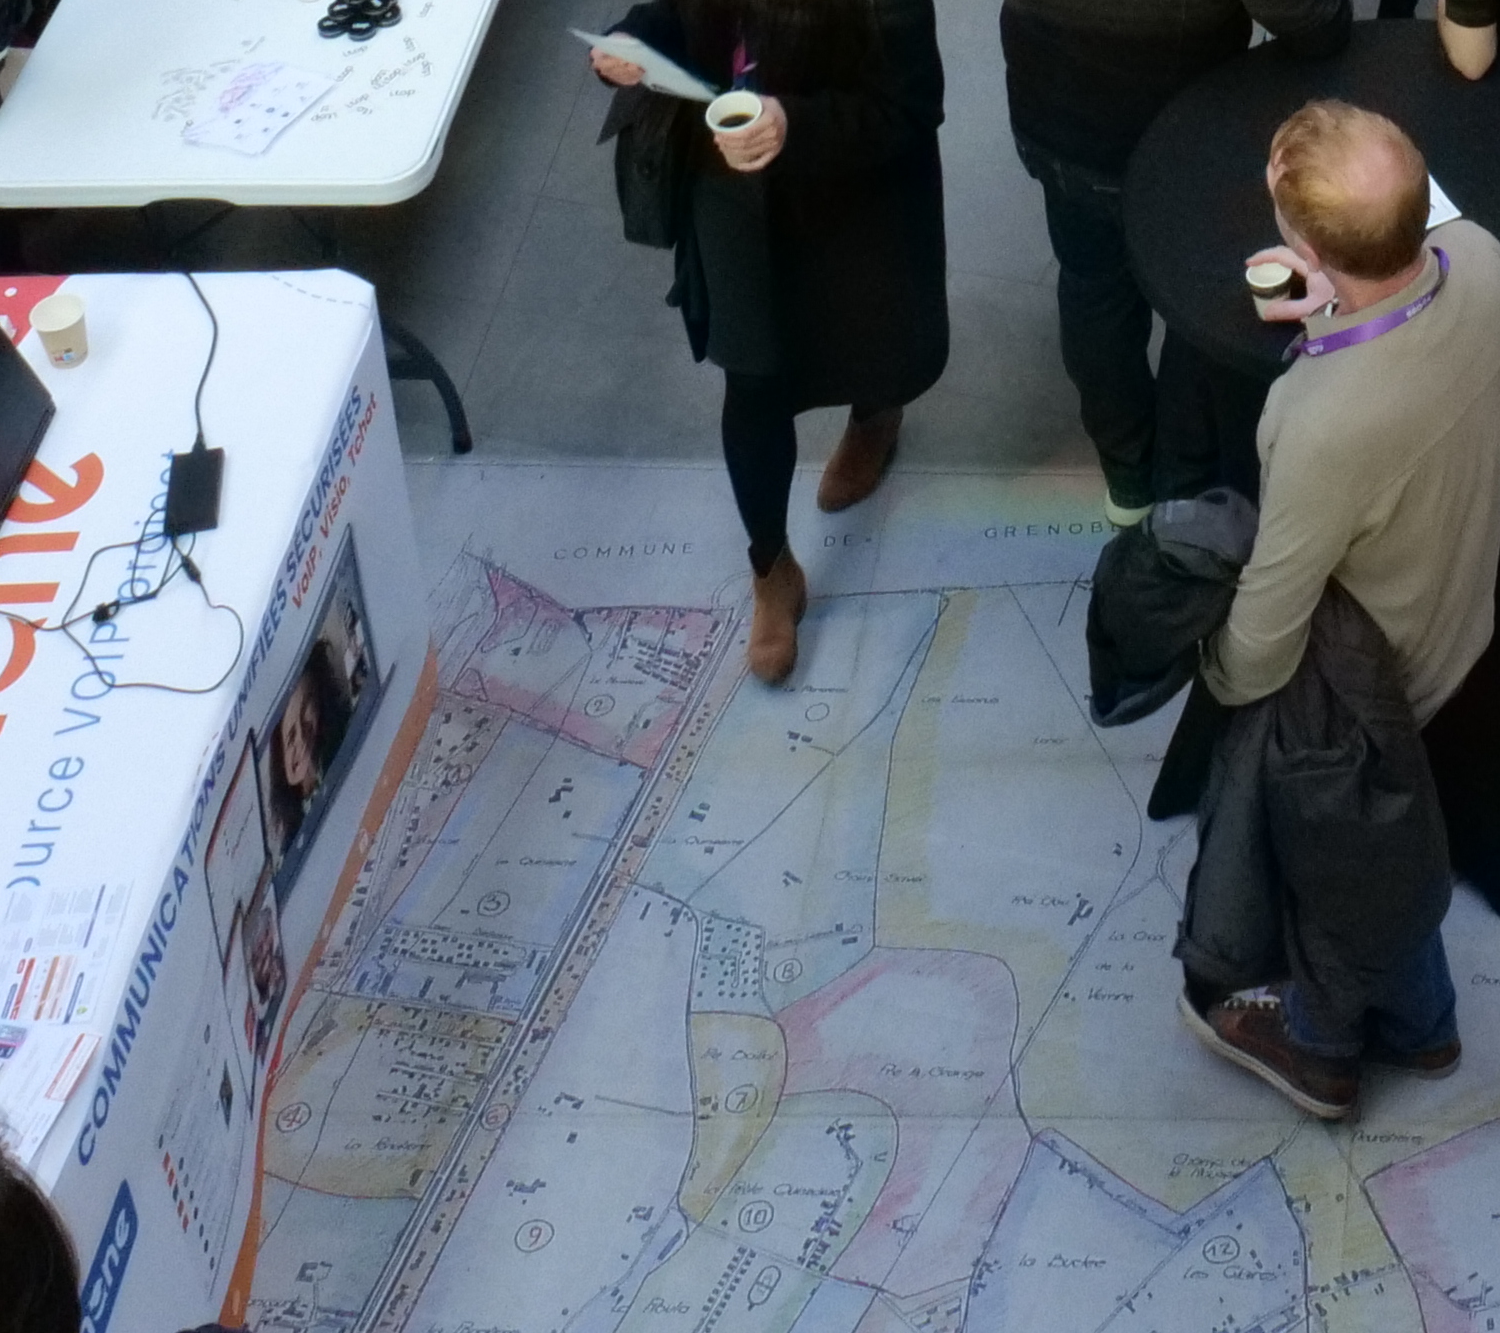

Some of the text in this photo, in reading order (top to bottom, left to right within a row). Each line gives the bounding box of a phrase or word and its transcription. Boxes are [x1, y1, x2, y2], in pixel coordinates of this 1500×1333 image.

[291, 391, 379, 610] VoIP, Visio, Tchat
[553, 540, 696, 561] COMMUNE
[823, 534, 856, 549] DE
[54, 618, 130, 736] VoIP
[78, 383, 363, 1167] COMMUNICATIONS UNIFIÉES SÉCURISÉES
